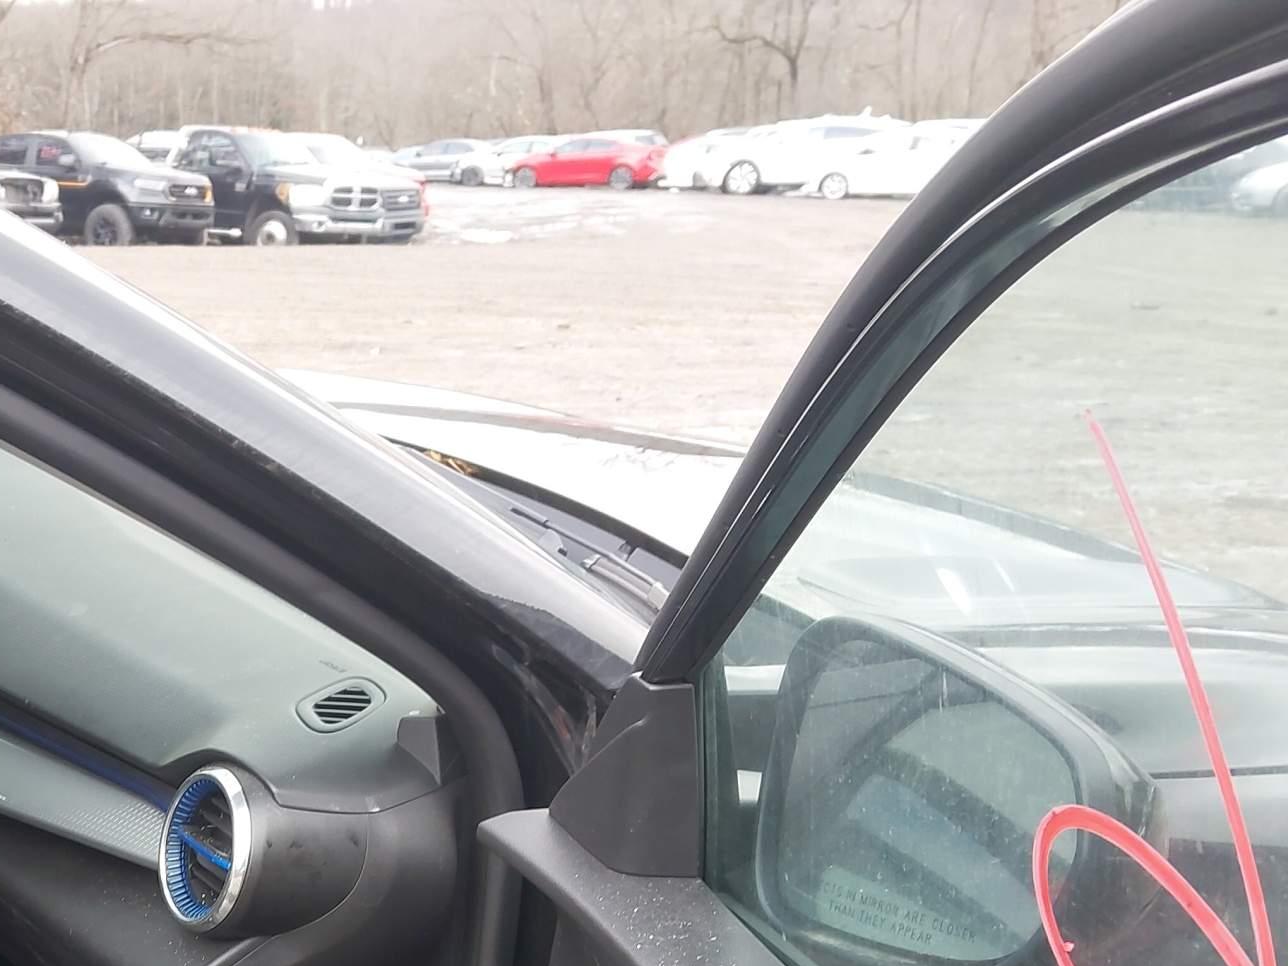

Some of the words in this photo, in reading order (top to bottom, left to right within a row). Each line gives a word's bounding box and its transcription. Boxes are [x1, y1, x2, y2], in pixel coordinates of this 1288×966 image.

[828, 899, 855, 918] THAN
[859, 911, 887, 927] THEY
[890, 922, 933, 945] APPEAR
[860, 891, 900, 918] MIRROR
[904, 910, 928, 926] ARE
[932, 918, 977, 944] CLOSER
